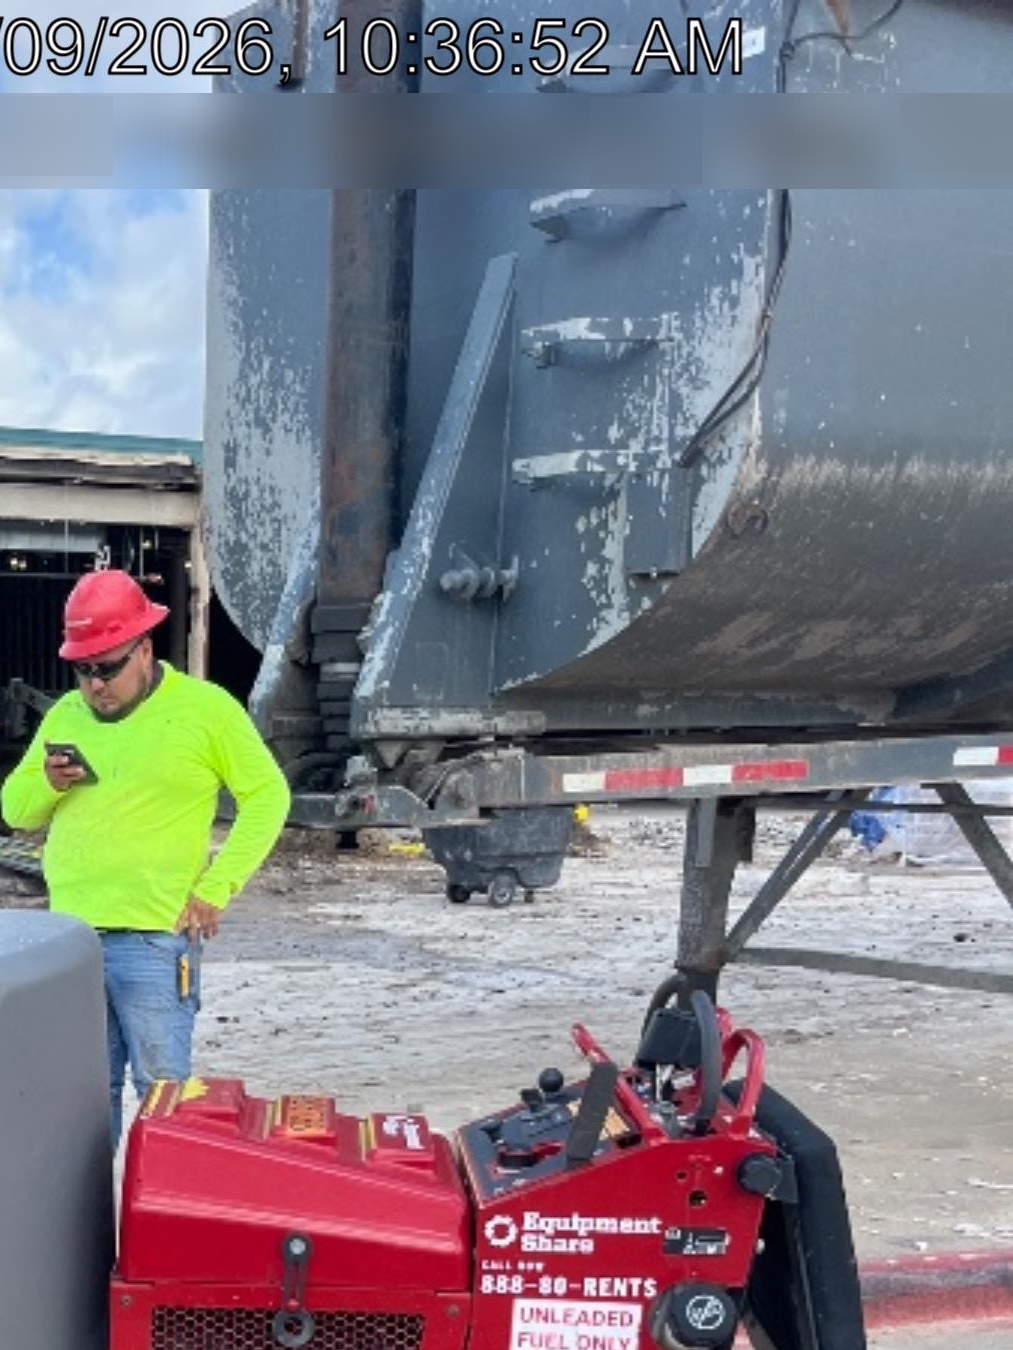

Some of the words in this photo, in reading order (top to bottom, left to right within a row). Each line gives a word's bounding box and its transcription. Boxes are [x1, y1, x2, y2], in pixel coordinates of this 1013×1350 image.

[523, 1211, 663, 1237] Equipment
[520, 1234, 595, 1253] Share
[520, 1306, 634, 1327] UNLEADED
[517, 1331, 570, 1350] FUEL
